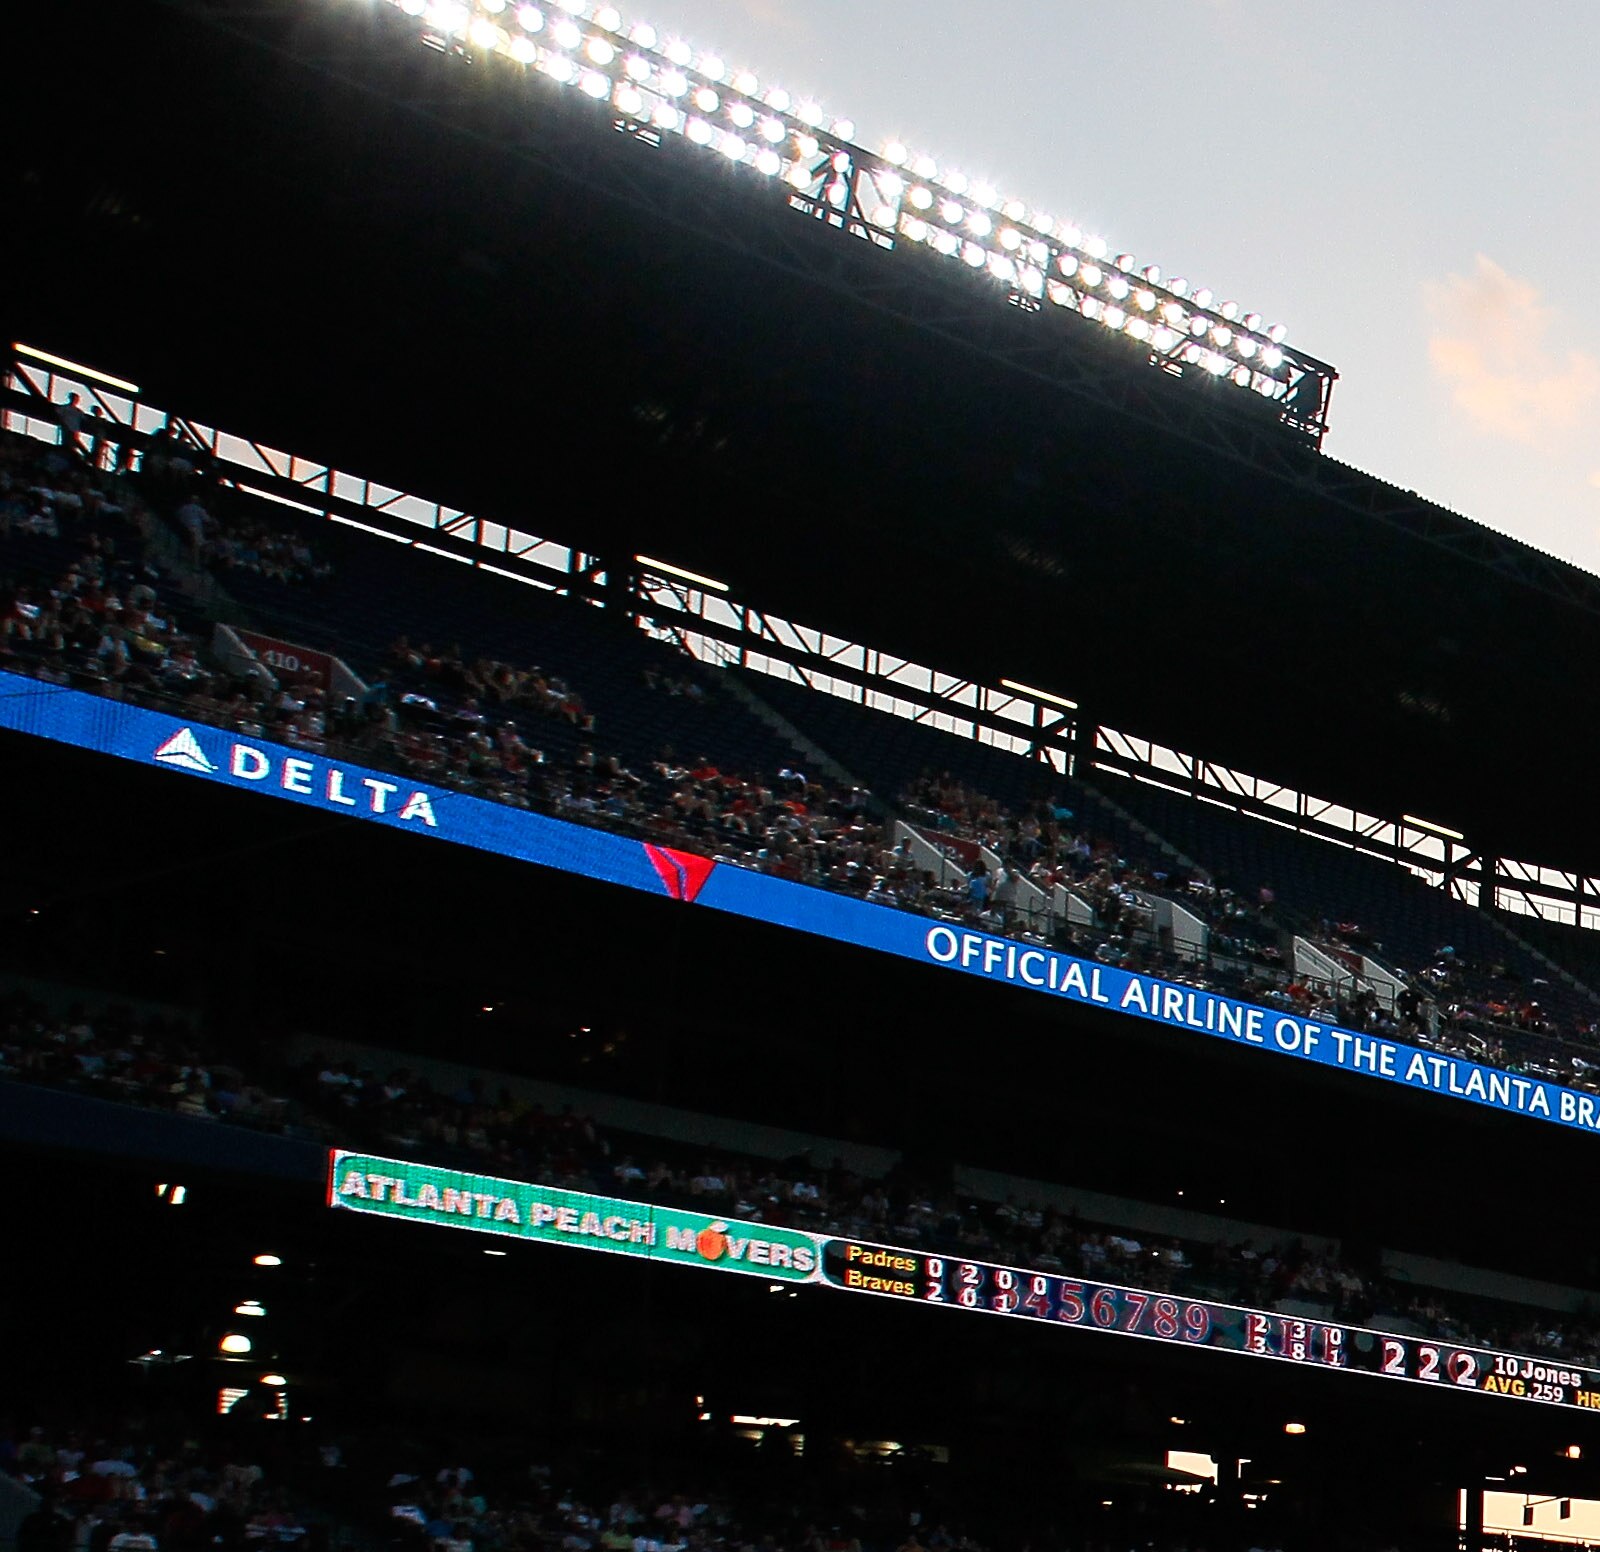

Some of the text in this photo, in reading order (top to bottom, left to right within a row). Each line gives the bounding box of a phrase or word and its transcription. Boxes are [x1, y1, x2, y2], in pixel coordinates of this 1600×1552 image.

[230, 743, 438, 827] DELTA
[926, 926, 1108, 1003] OFFICIAL
[1121, 979, 1264, 1043] AIRLINE
[1274, 1017, 1321, 1055] OF
[1331, 1031, 1397, 1077] THE
[1405, 1053, 1550, 1116] ATLANTA
[339, 1171, 520, 1224] ATLANTA
[530, 1202, 656, 1245] PEACH
[846, 1268, 915, 1296] Braves
[926, 1282, 944, 1302] 2
[847, 1245, 1047, 1296] Padres 0 2 0 0
[1059, 1281, 1085, 1323] 5
[1092, 1288, 1117, 1328] 6
[1125, 1294, 1149, 1332] 7
[1153, 1299, 1179, 1337] 8
[1186, 1303, 1209, 1341] 9
[1383, 1340, 1478, 1387] 2 2 2
[1484, 1375, 1526, 1397] AVG
[1494, 1356, 1517, 1377] 10
[1521, 1360, 1582, 1388] Jones
